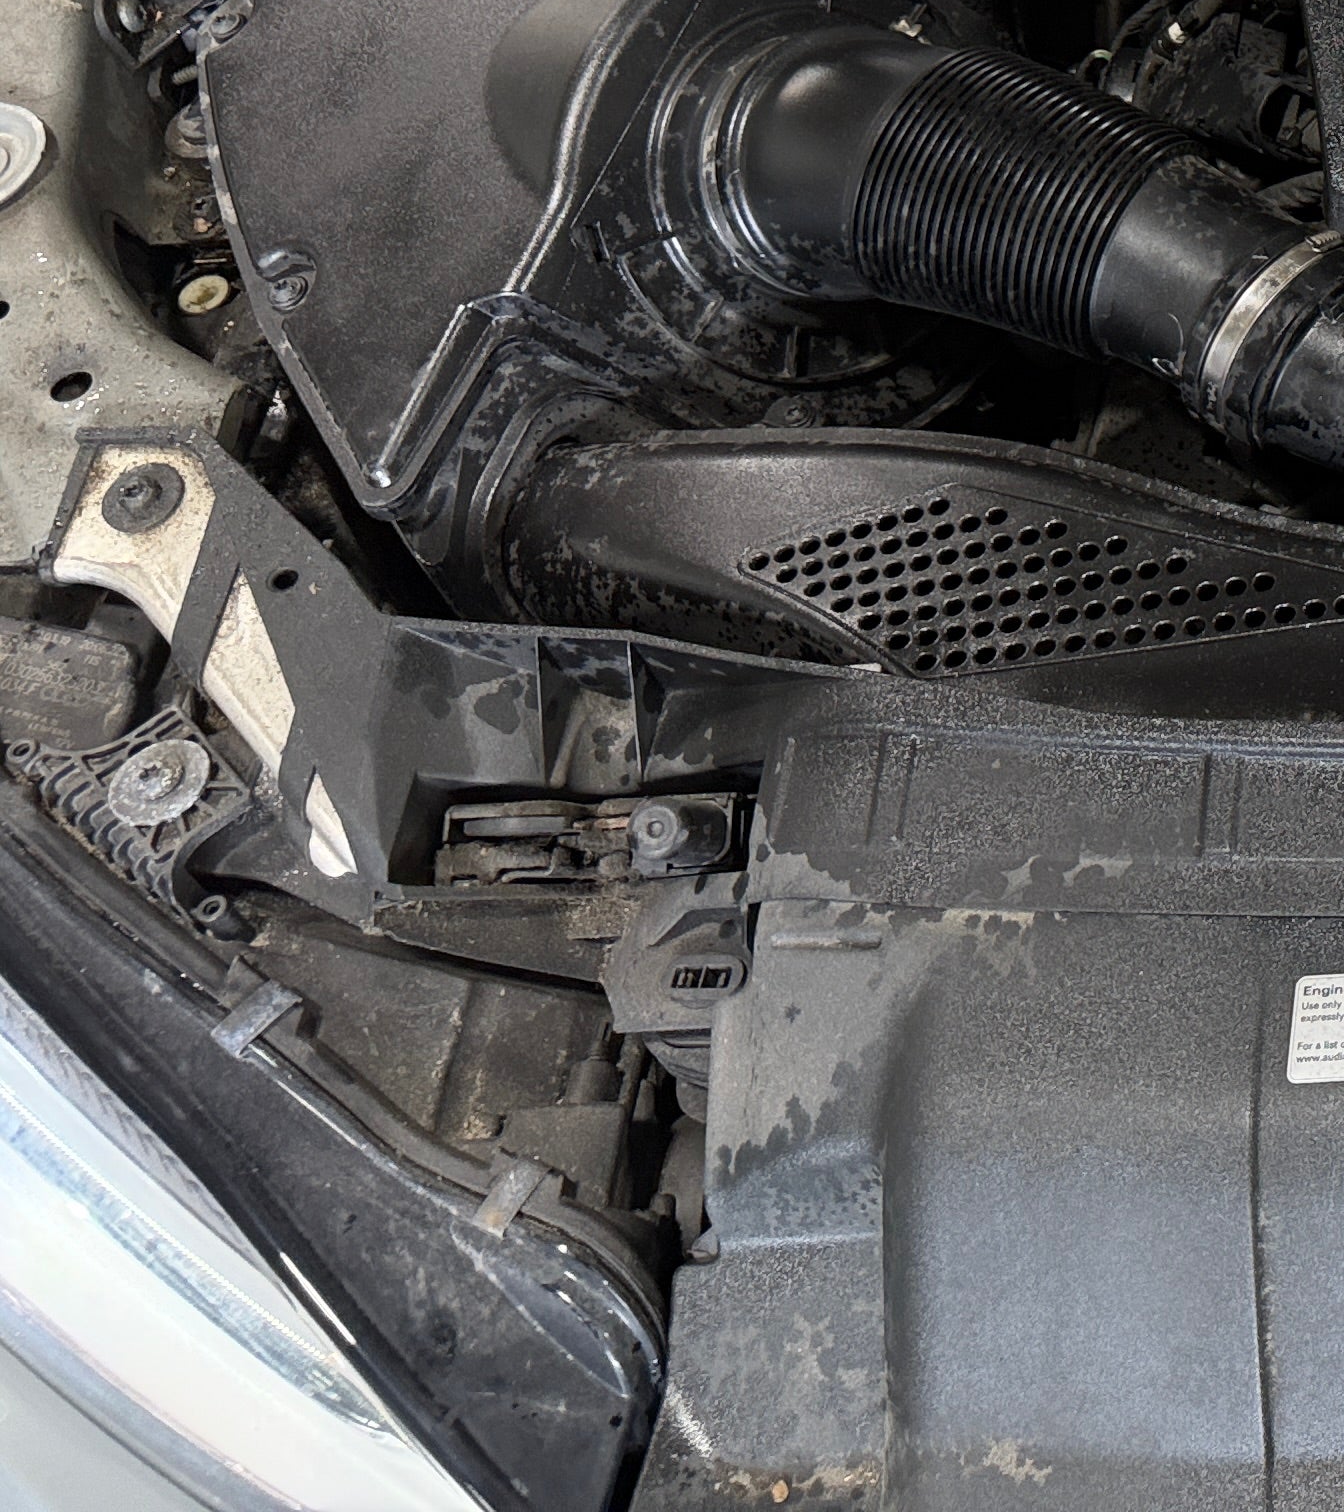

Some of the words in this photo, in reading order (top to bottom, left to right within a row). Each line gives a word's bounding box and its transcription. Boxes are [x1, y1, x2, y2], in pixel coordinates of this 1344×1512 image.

[1302, 1002, 1319, 1010] Use
[1322, 1000, 1342, 1009] only
[1301, 1012, 1344, 1023] expressly
[1297, 1042, 1313, 1050] For
[1324, 1041, 1338, 1049] list
